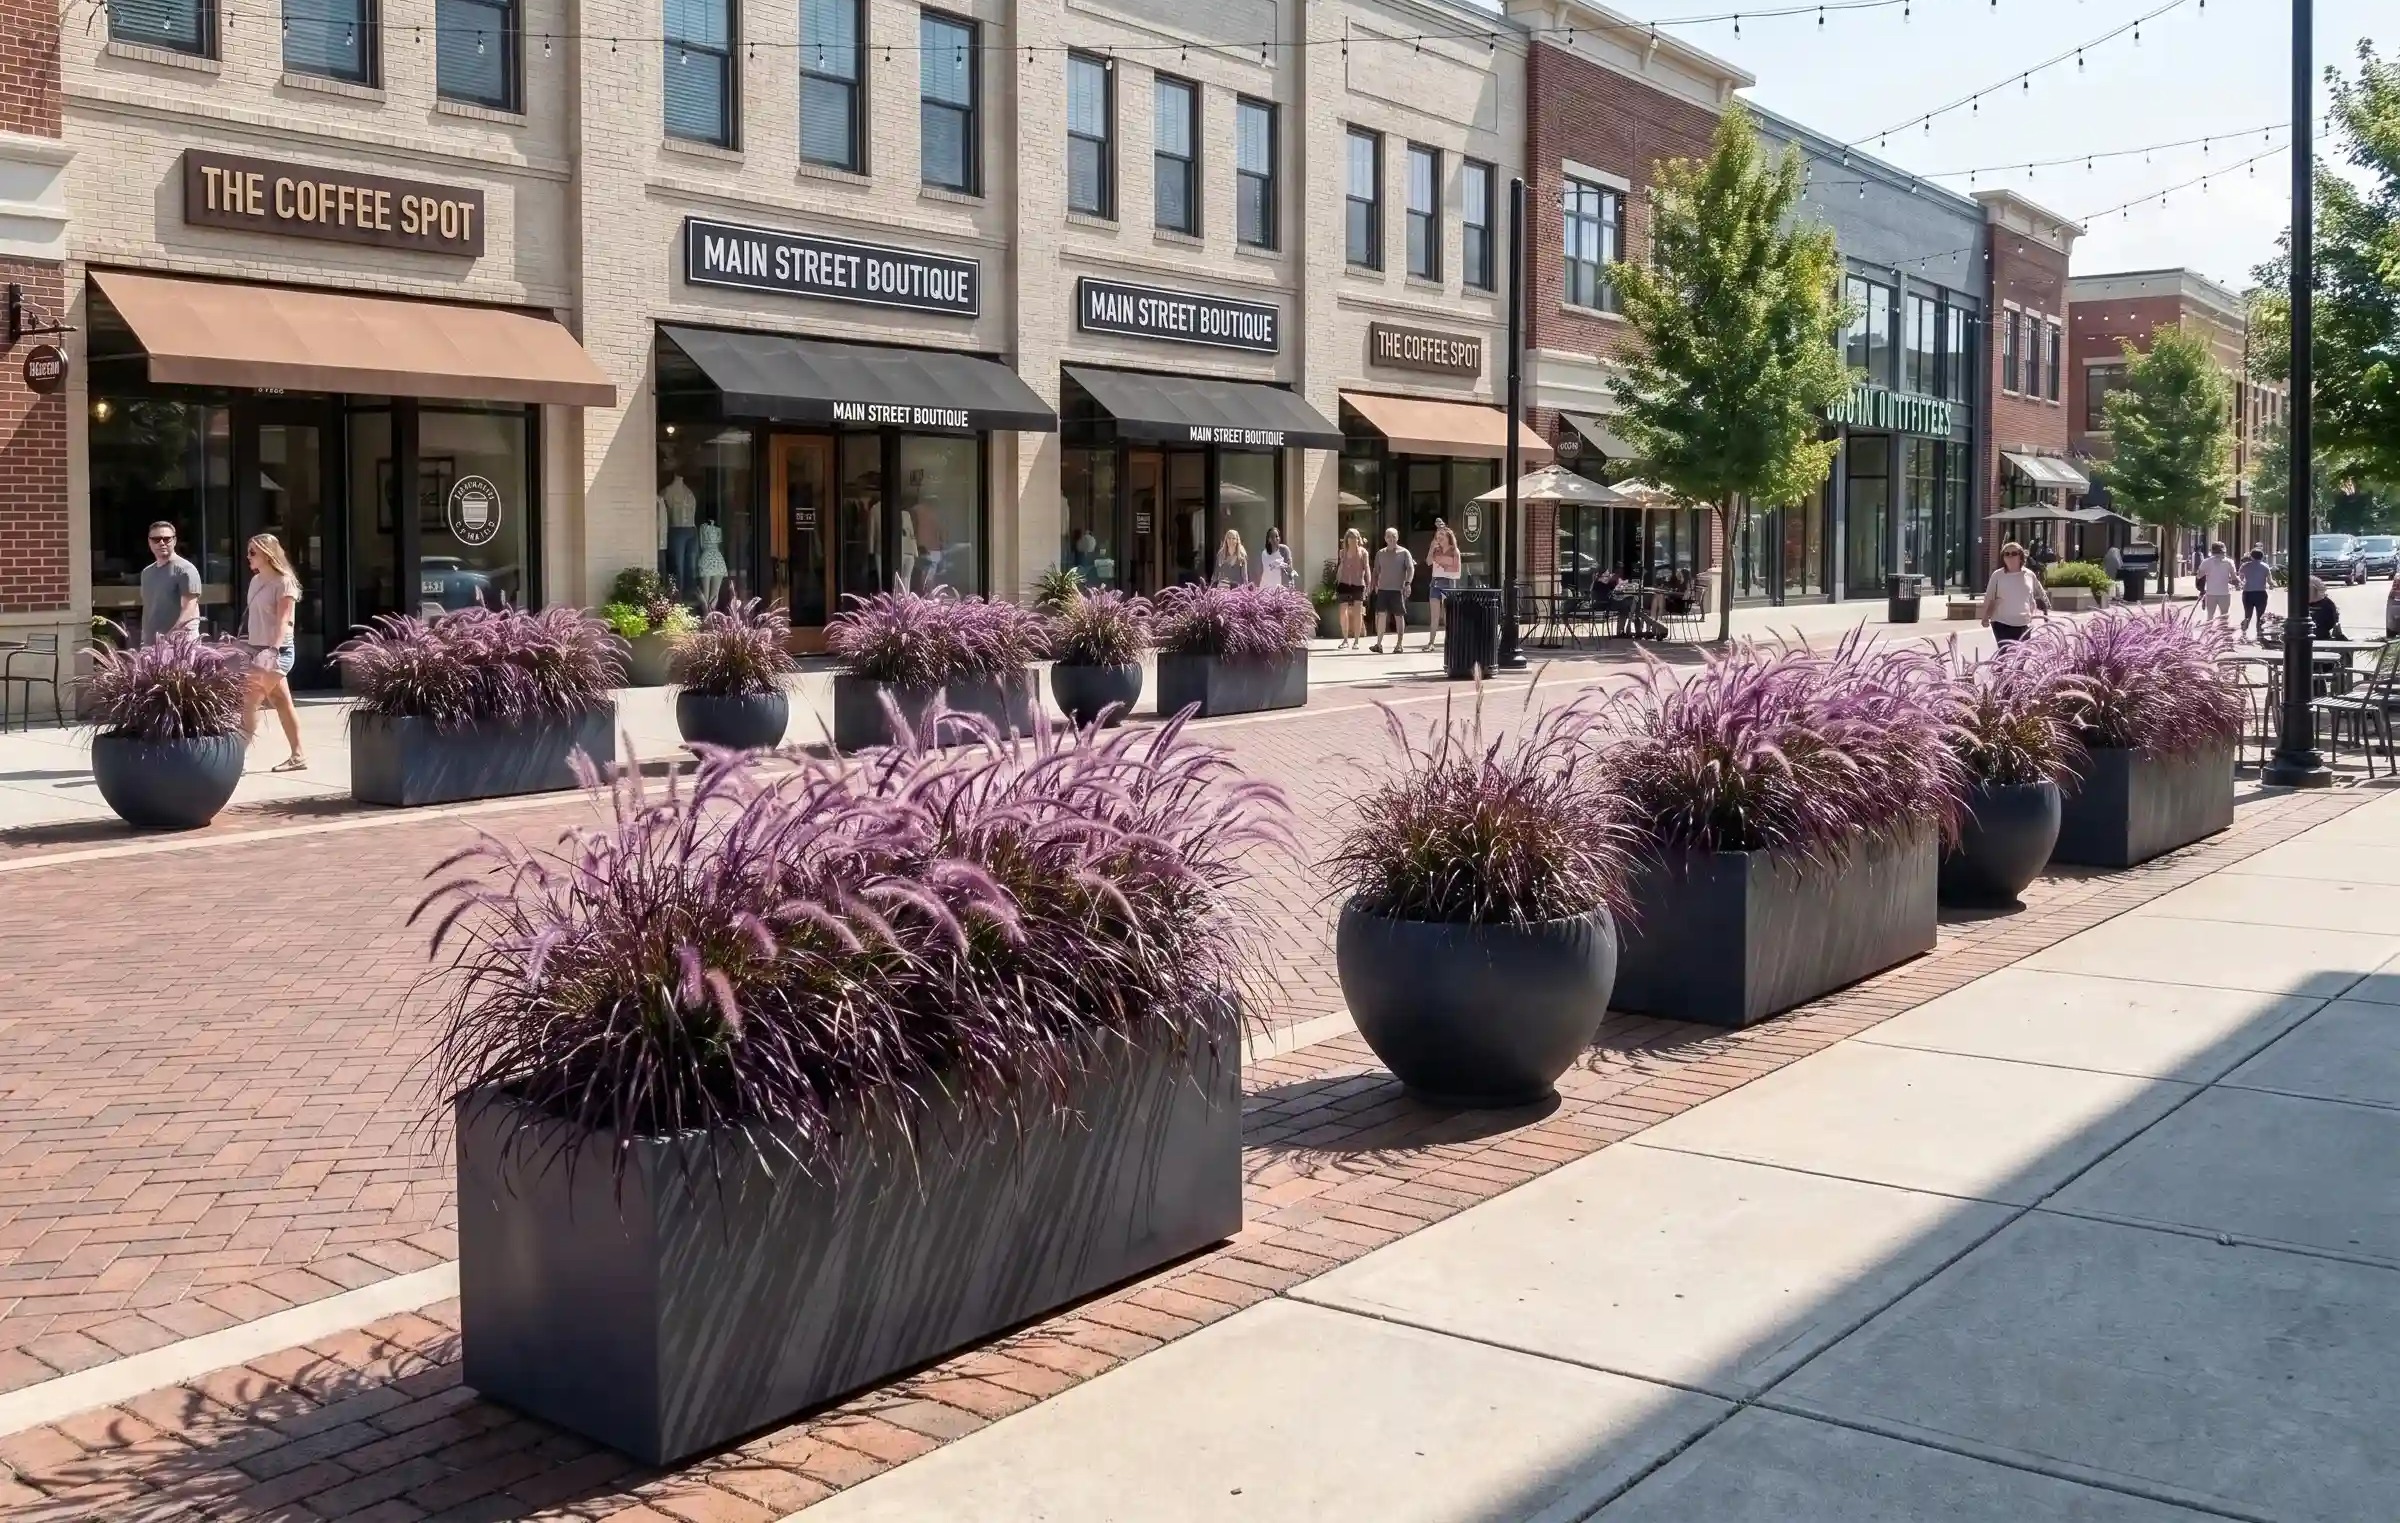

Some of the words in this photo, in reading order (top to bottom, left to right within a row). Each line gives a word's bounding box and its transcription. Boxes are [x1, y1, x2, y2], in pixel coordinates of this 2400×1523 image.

[200, 165, 266, 216] THE
[275, 177, 392, 231] COFFEE
[400, 194, 476, 241] SPOT
[704, 234, 768, 278] MAIN
[774, 245, 861, 289] STREET
[866, 258, 969, 304] BOUTIQUE
[1091, 290, 1134, 325] MAIN
[1138, 297, 1197, 333] STREET
[1200, 306, 1273, 343] BOUTIQUE
[1378, 330, 1402, 358] THE
[1404, 335, 1449, 365] COFFEE
[1450, 341, 1480, 368] SPOT
[833, 401, 865, 421] MAIN
[868, 404, 912, 424] STREET
[913, 407, 969, 429] BOUTIQUE
[1190, 426, 1212, 442] MAIN
[1213, 427, 1244, 444] STREET
[1245, 429, 1285, 446] BOUTIQUE
